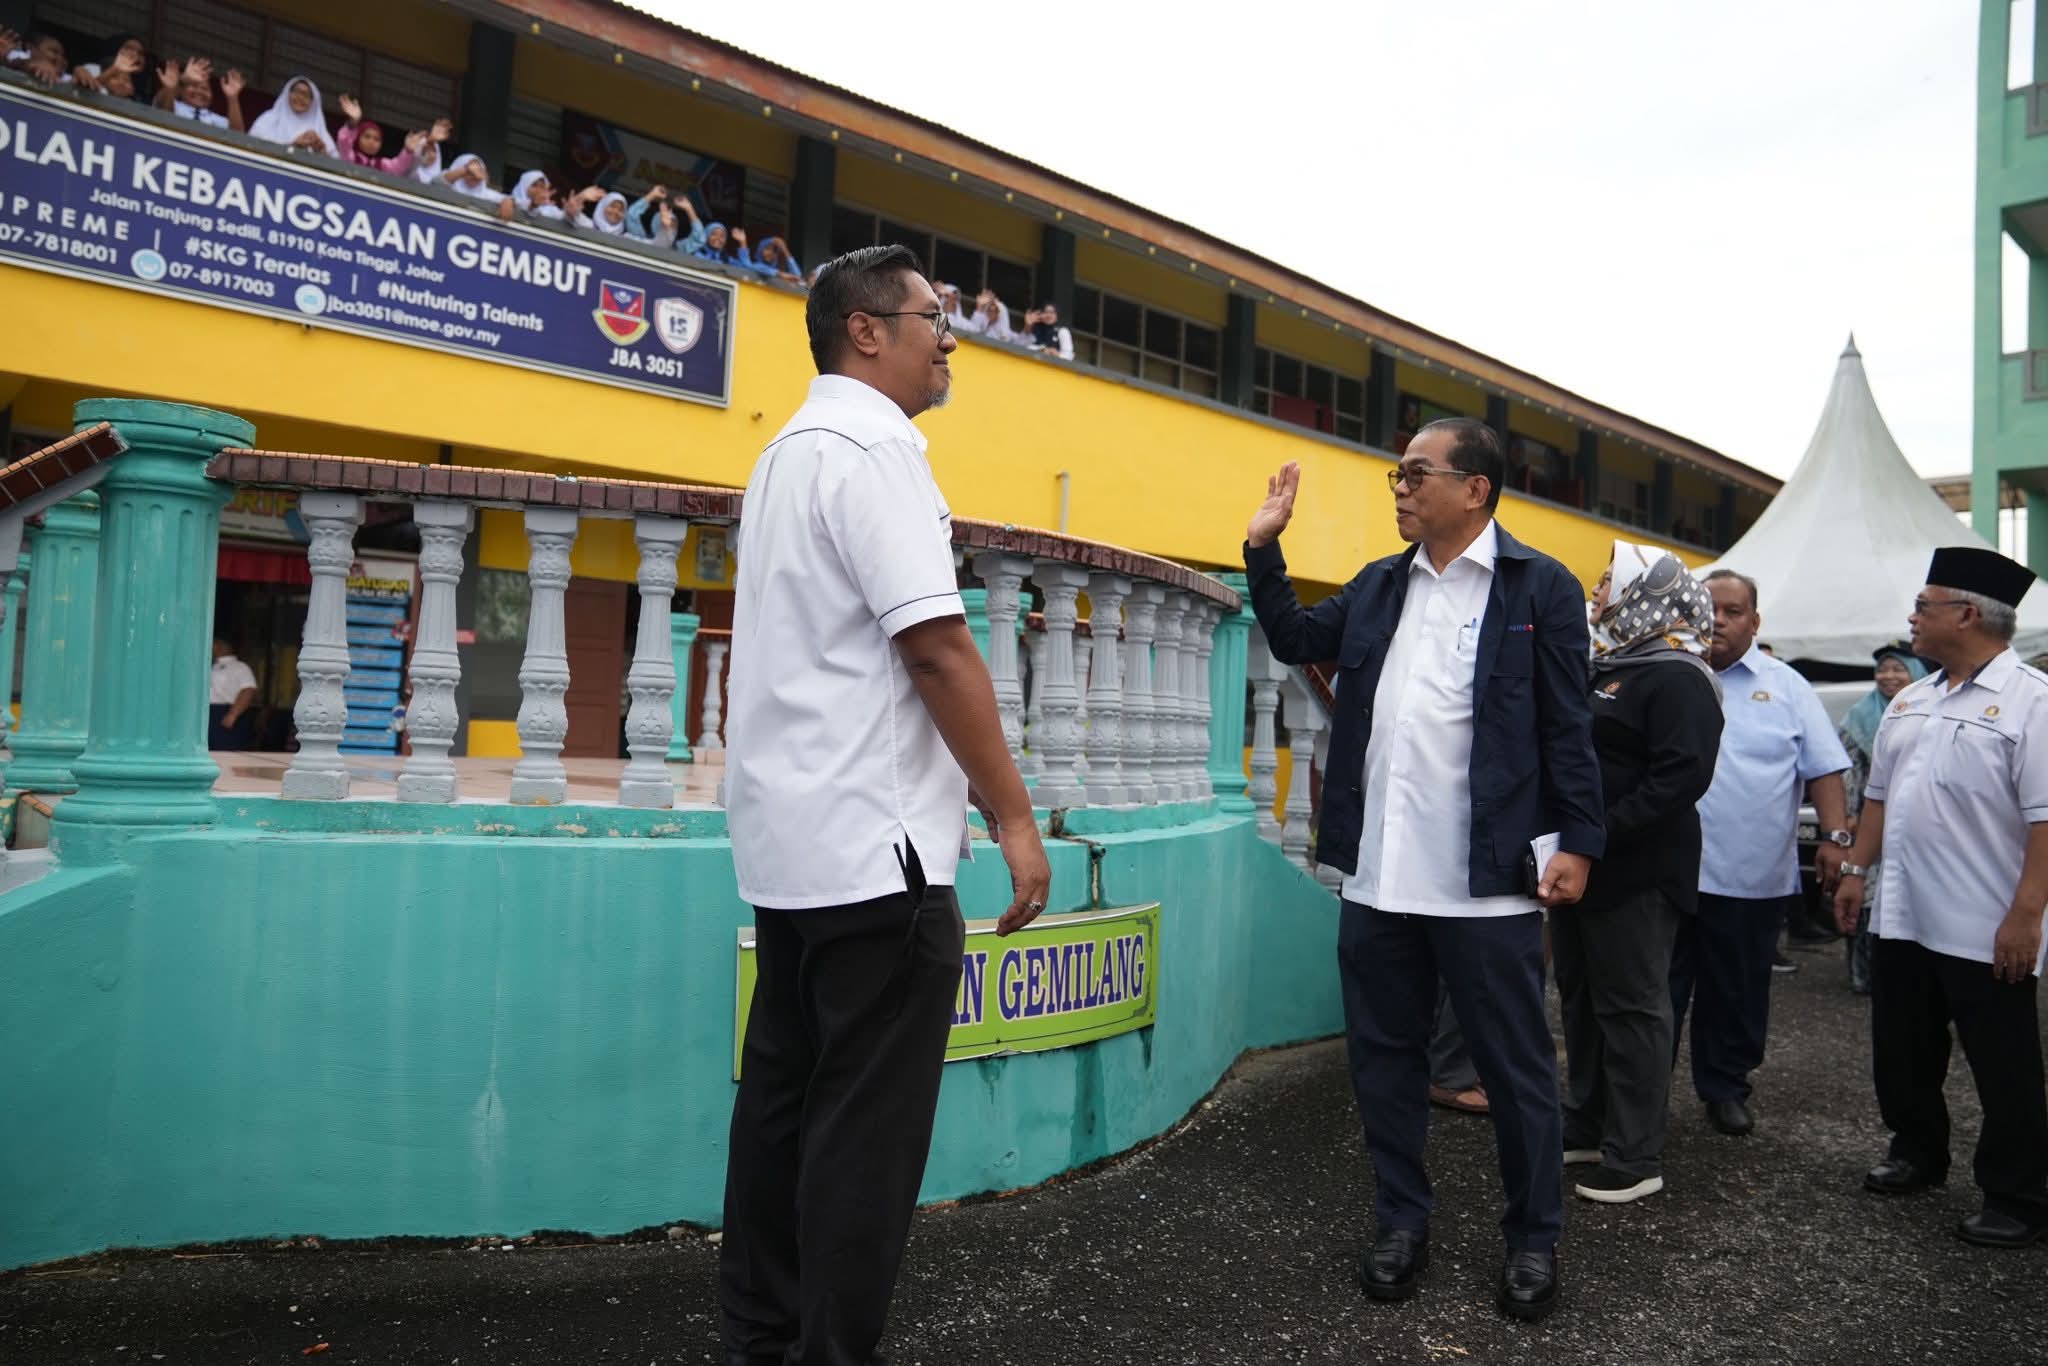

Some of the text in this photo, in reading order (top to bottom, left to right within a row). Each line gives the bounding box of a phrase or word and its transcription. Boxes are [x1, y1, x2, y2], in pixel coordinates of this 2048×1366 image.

[0, 192, 544, 332] PREME #SKG Teratas #Nurturing Talents
[89, 188, 141, 213] Jalan
[144, 200, 214, 232] Tanjung
[267, 230, 315, 252] 81910
[317, 242, 353, 262] Kota
[405, 262, 446, 283] Johor
[131, 152, 437, 260] KEBANGSAAN
[447, 234, 592, 296] GEMBUT
[168, 261, 276, 298] 07-8917003
[326, 295, 501, 347] jba3051@moe.gov.my
[609, 347, 684, 379] JBA 3051
[999, 934, 1146, 1022] GEMILANG
